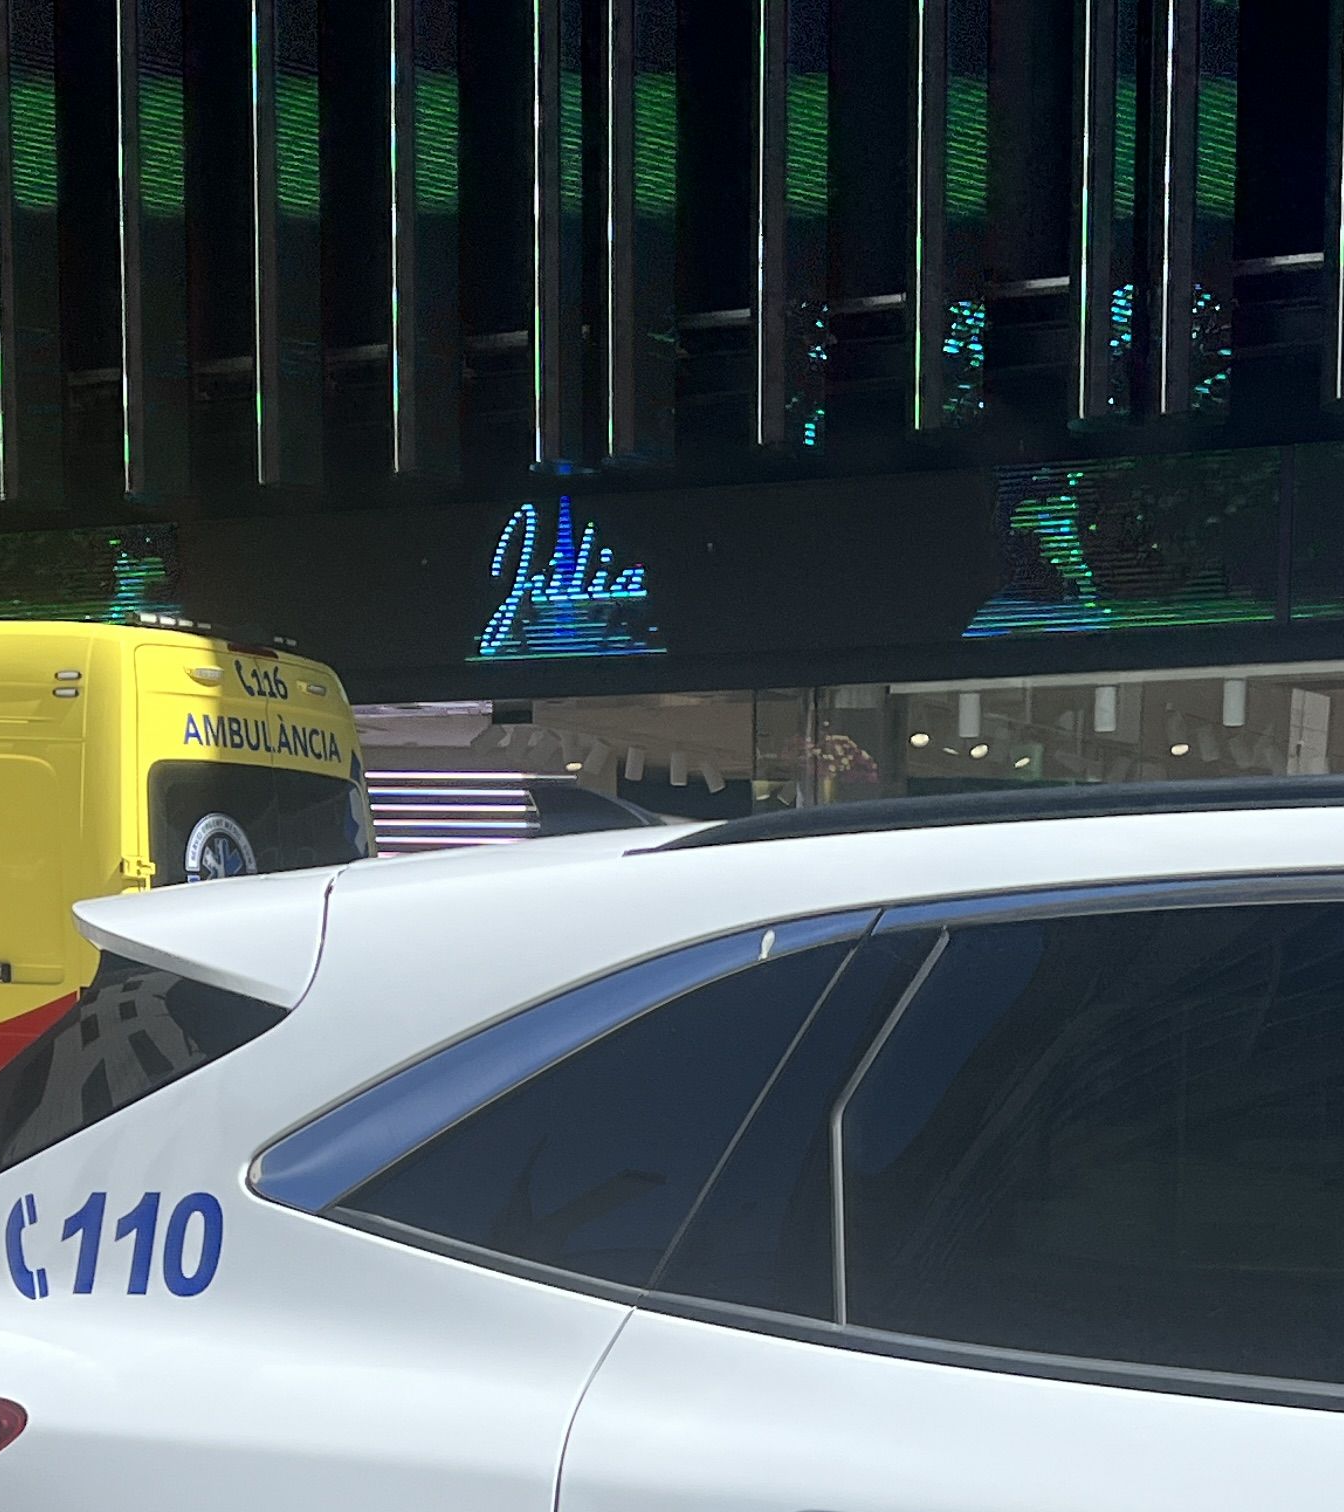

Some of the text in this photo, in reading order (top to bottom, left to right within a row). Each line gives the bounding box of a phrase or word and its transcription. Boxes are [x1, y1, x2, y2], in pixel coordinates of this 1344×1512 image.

[251, 665, 289, 700] 116
[183, 713, 342, 764] AMBULÀNCIA
[60, 1191, 224, 1297] 110
